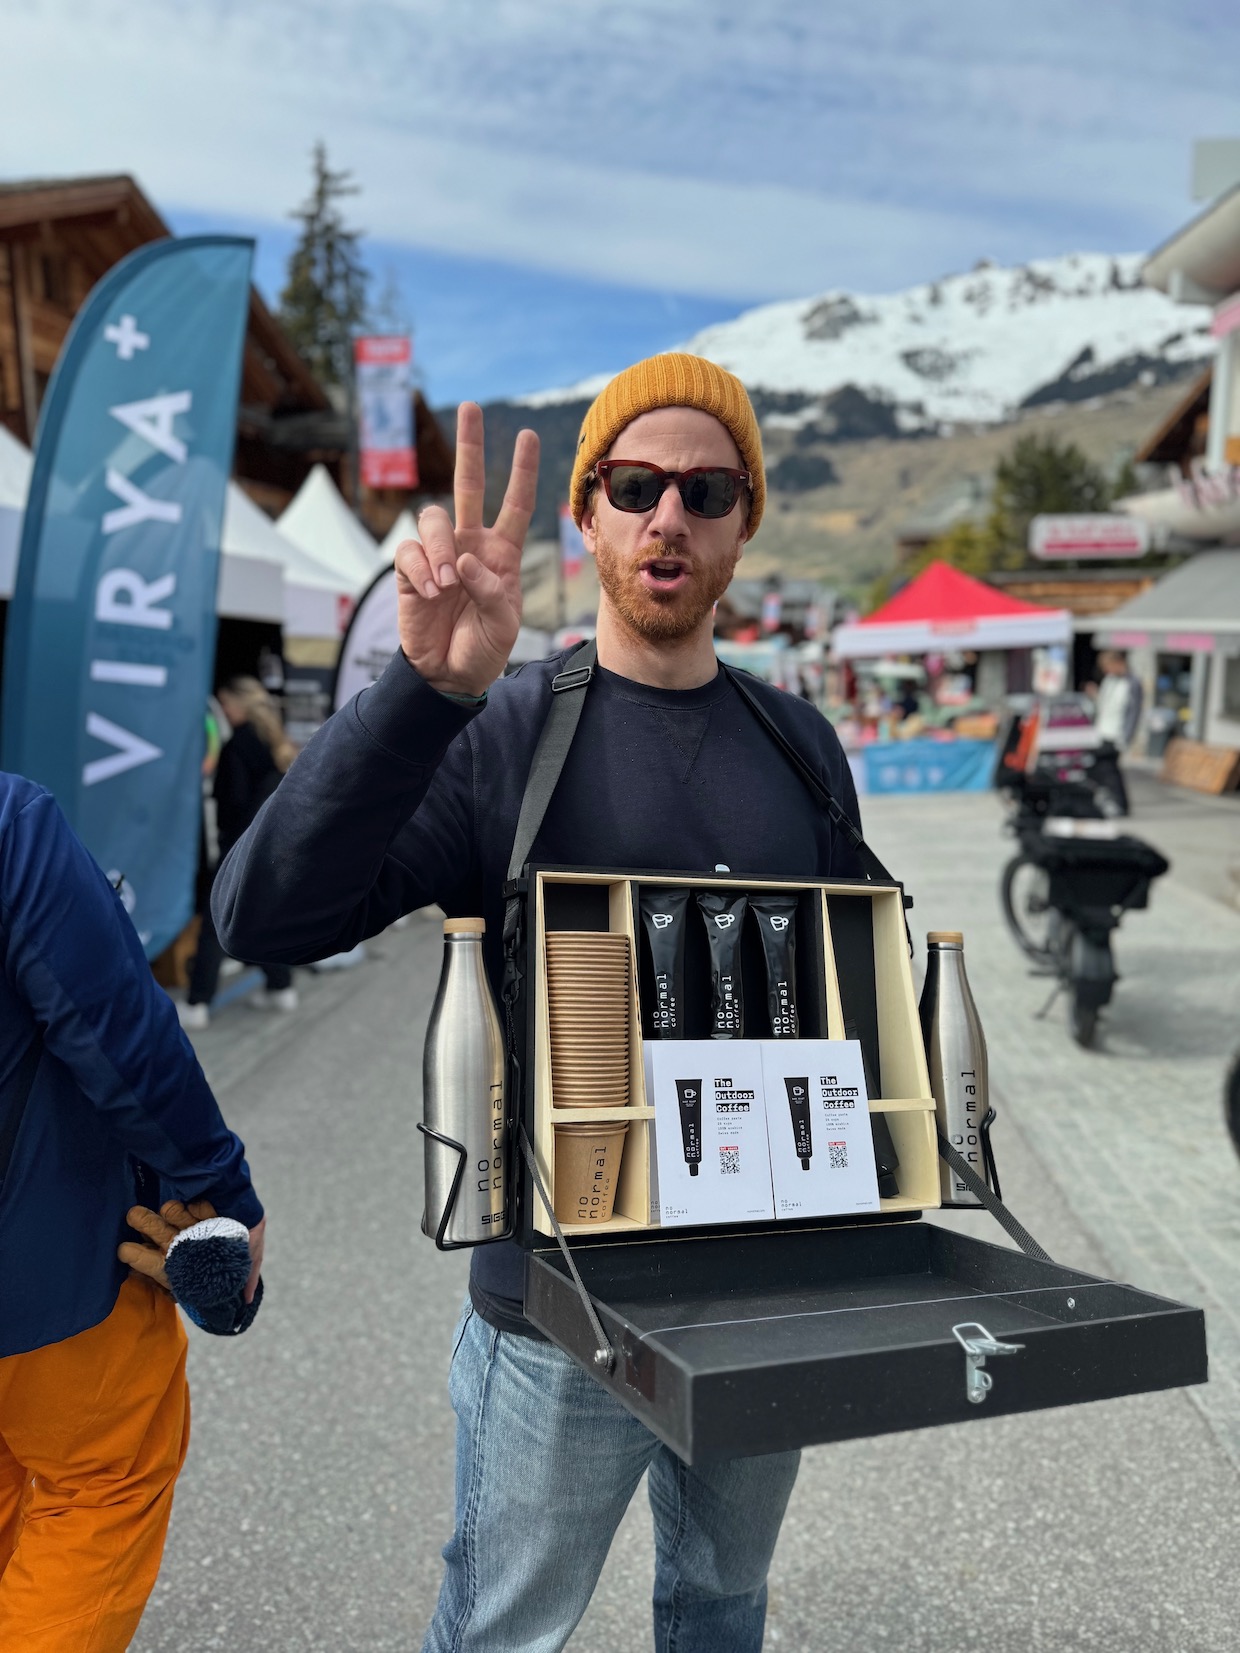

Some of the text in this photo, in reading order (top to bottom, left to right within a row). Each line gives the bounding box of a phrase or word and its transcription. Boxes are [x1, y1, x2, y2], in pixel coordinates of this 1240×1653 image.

[657, 973, 669, 1028] normal
[722, 975, 734, 1029] normal
[778, 981, 790, 1034] normal
[653, 1011, 660, 1029] no
[717, 1012, 725, 1029] no
[773, 1017, 781, 1034] no
[715, 1079, 732, 1087] The
[821, 1077, 837, 1085] The
[716, 1091, 754, 1100] Outdoor
[822, 1088, 858, 1097] Outdoor
[716, 1103, 750, 1112] Coffee
[823, 1100, 854, 1109] Coffee
[961, 1070, 978, 1162] normal
[490, 1080, 502, 1190] normal
[477, 1159, 489, 1192] no
[589, 1146, 606, 1219] normal
[578, 1197, 588, 1218] no
